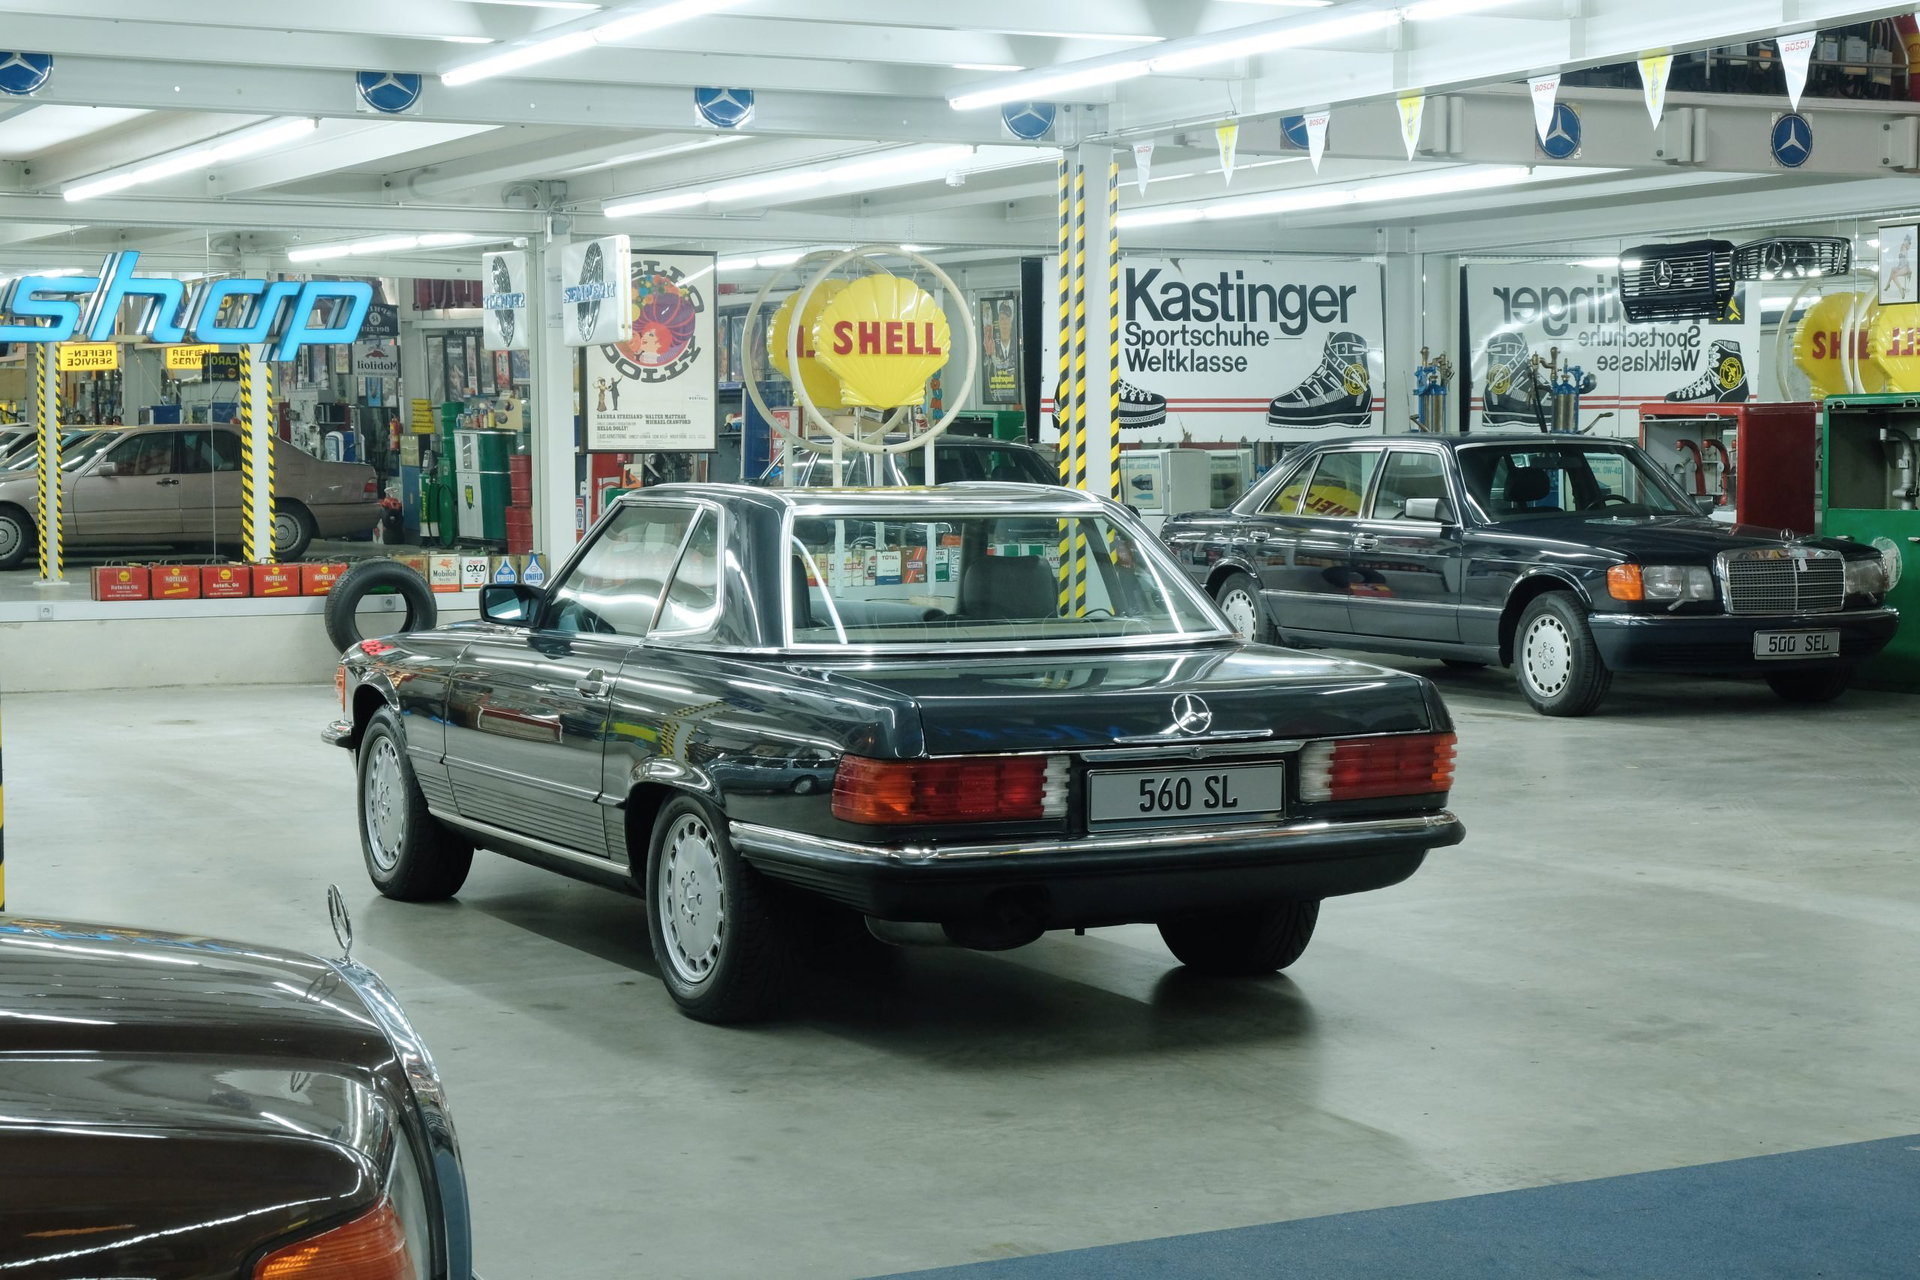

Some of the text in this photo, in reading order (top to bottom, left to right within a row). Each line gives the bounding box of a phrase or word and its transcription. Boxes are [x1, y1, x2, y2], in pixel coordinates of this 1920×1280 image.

[1783, 38, 1810, 52] BOSCH
[1534, 81, 1555, 92] BOSCH
[1308, 117, 1326, 127] BOSCH
[1136, 145, 1152, 153] BOSCH
[631, 260, 704, 313] ELLO
[0, 250, 373, 361] shop
[1125, 268, 1356, 336] Kastinger
[833, 320, 942, 355] SHELL
[1125, 322, 1269, 350] Sportschuhe
[600, 335, 702, 383] DOLLY
[1125, 347, 1248, 373] Weltklasse
[433, 569, 457, 578] Mobiloil
[466, 564, 486, 573] CXD
[524, 573, 543, 581] UNIFLO
[1768, 634, 1829, 652] 500 SEL
[1139, 774, 1238, 812] 560 SL
